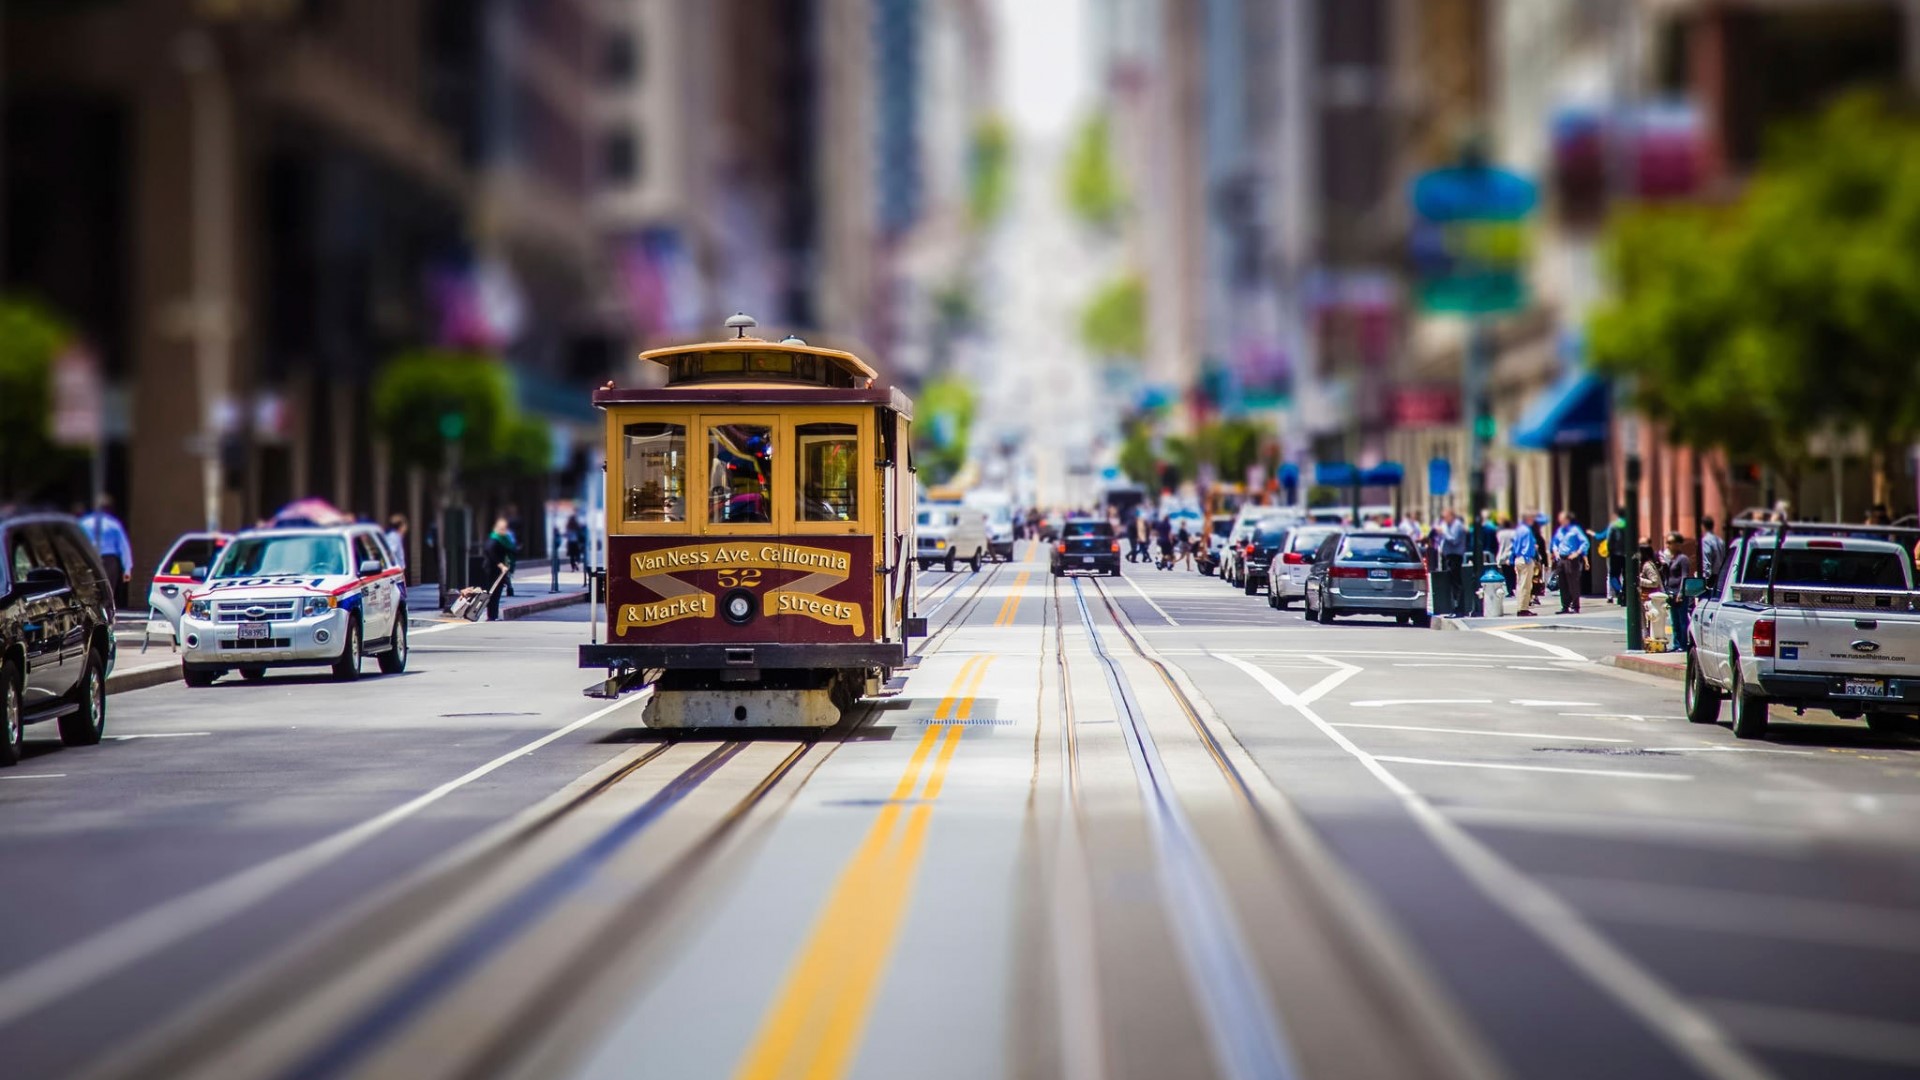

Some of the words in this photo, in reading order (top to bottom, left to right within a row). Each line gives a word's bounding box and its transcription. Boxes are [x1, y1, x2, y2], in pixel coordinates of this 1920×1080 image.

[634, 554, 665, 571] Van
[667, 550, 709, 568] Ness
[760, 547, 848, 570] California
[717, 569, 761, 587] 52
[627, 607, 640, 622] &
[644, 598, 707, 622] Market
[778, 595, 852, 619] Streets
